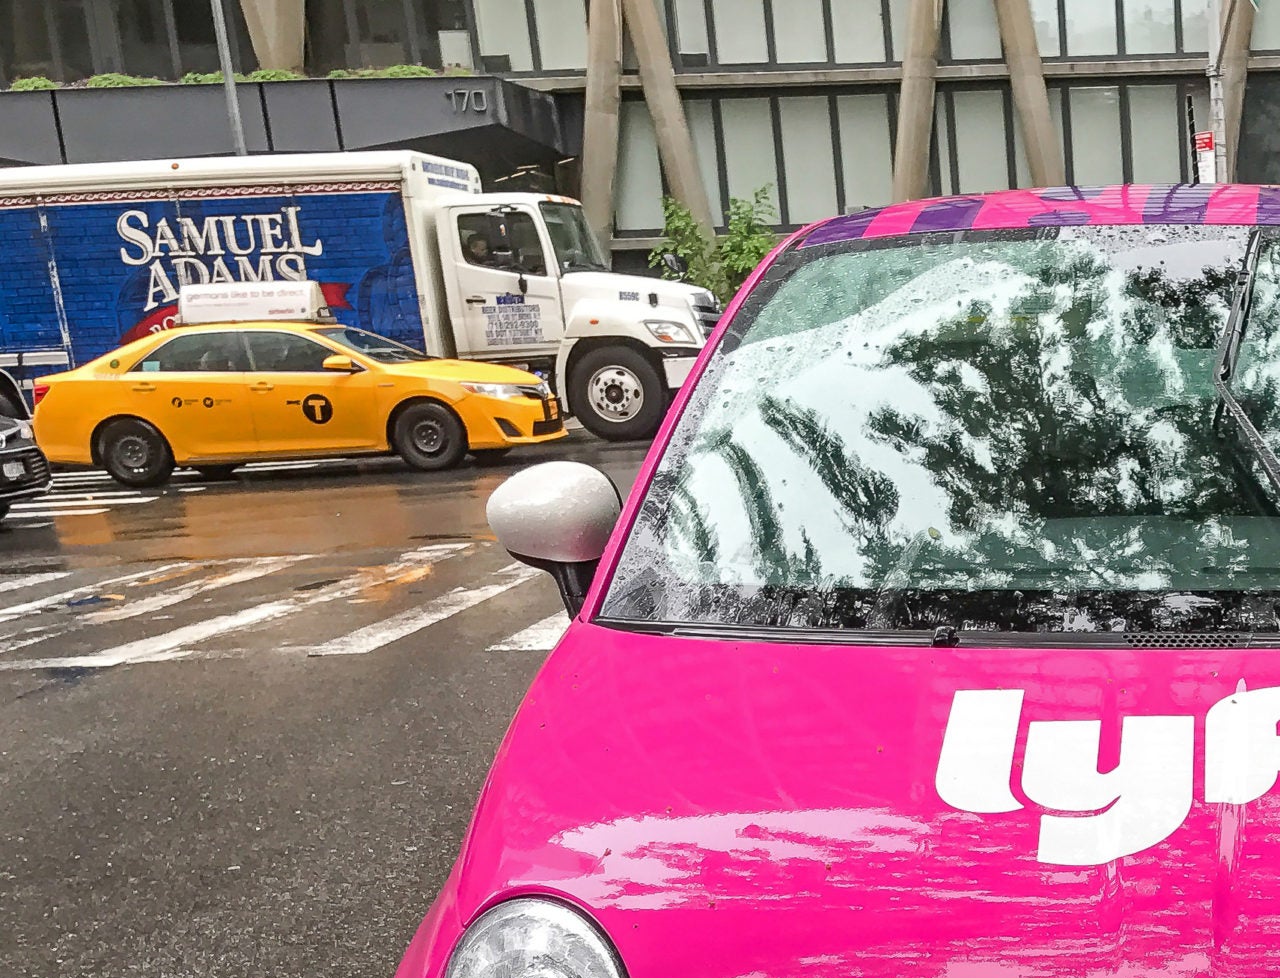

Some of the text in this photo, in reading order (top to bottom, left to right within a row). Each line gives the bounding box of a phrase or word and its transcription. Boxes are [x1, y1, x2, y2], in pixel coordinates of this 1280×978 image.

[446, 89, 487, 113] 170
[116, 206, 323, 266] SAMUEL
[144, 254, 308, 312] ADAMS
